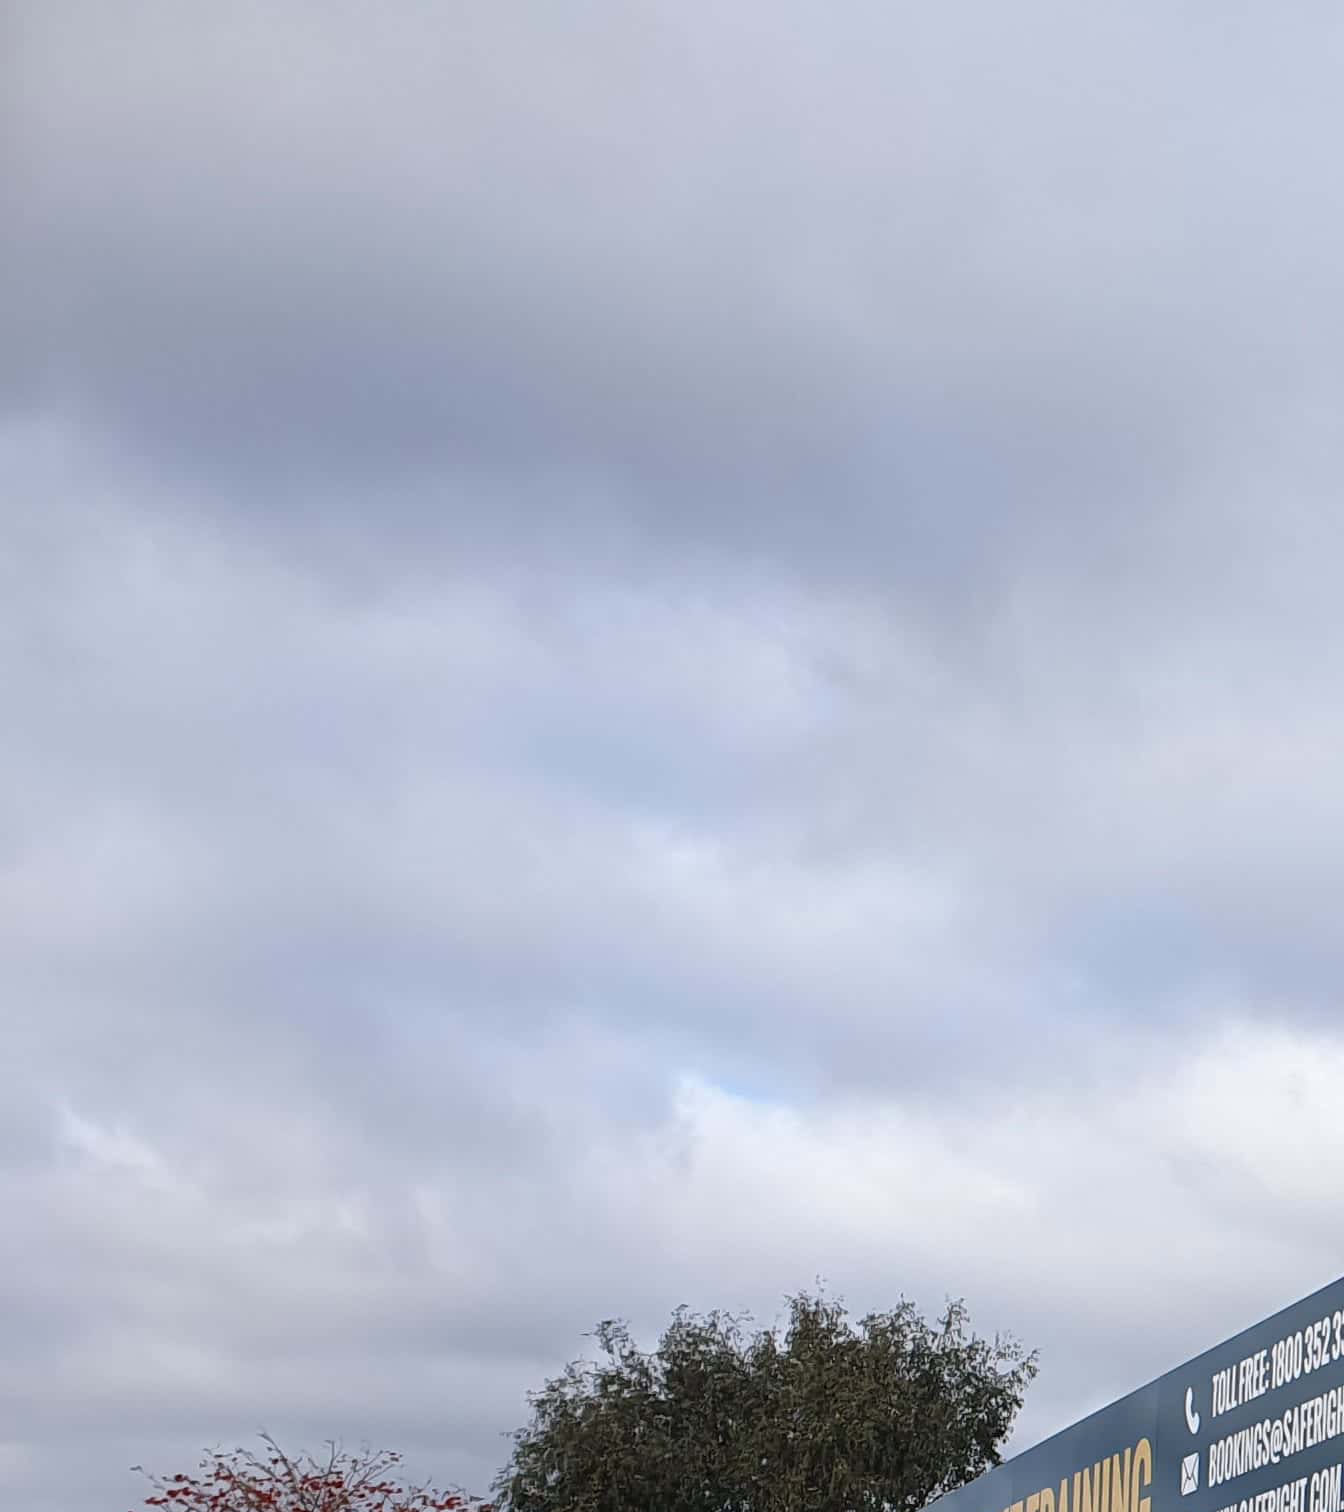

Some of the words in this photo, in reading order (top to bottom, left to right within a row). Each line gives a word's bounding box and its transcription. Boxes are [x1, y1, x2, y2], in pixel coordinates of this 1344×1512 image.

[1211, 1373, 1238, 1418] TOLL
[1237, 1349, 1270, 1402] FREE:
[1271, 1332, 1303, 1390] 1800
[1304, 1318, 1331, 1374] 352
